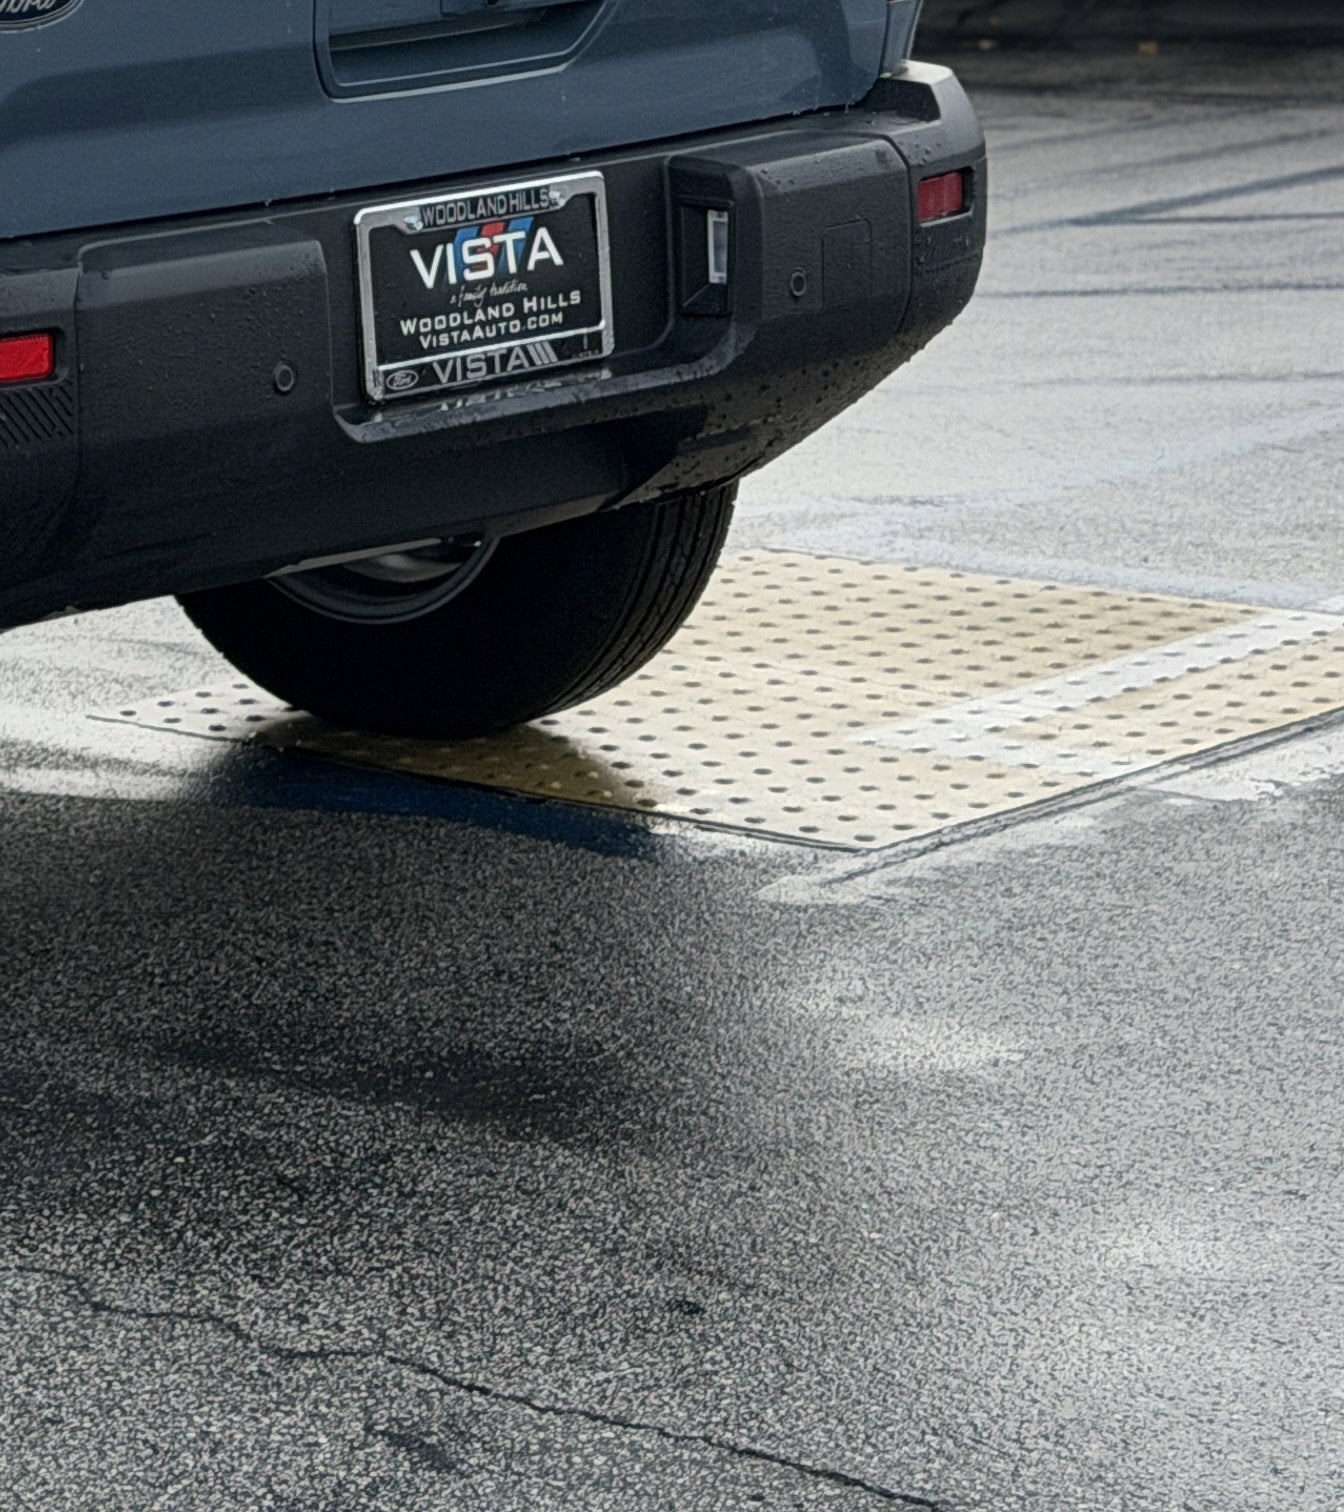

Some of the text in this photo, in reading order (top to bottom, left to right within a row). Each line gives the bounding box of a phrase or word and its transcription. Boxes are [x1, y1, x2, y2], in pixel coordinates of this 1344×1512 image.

[421, 188, 550, 226] WOODLAND HILLS
[410, 227, 564, 289] VISTA
[457, 285, 487, 307] family
[433, 346, 530, 384] VISTA
